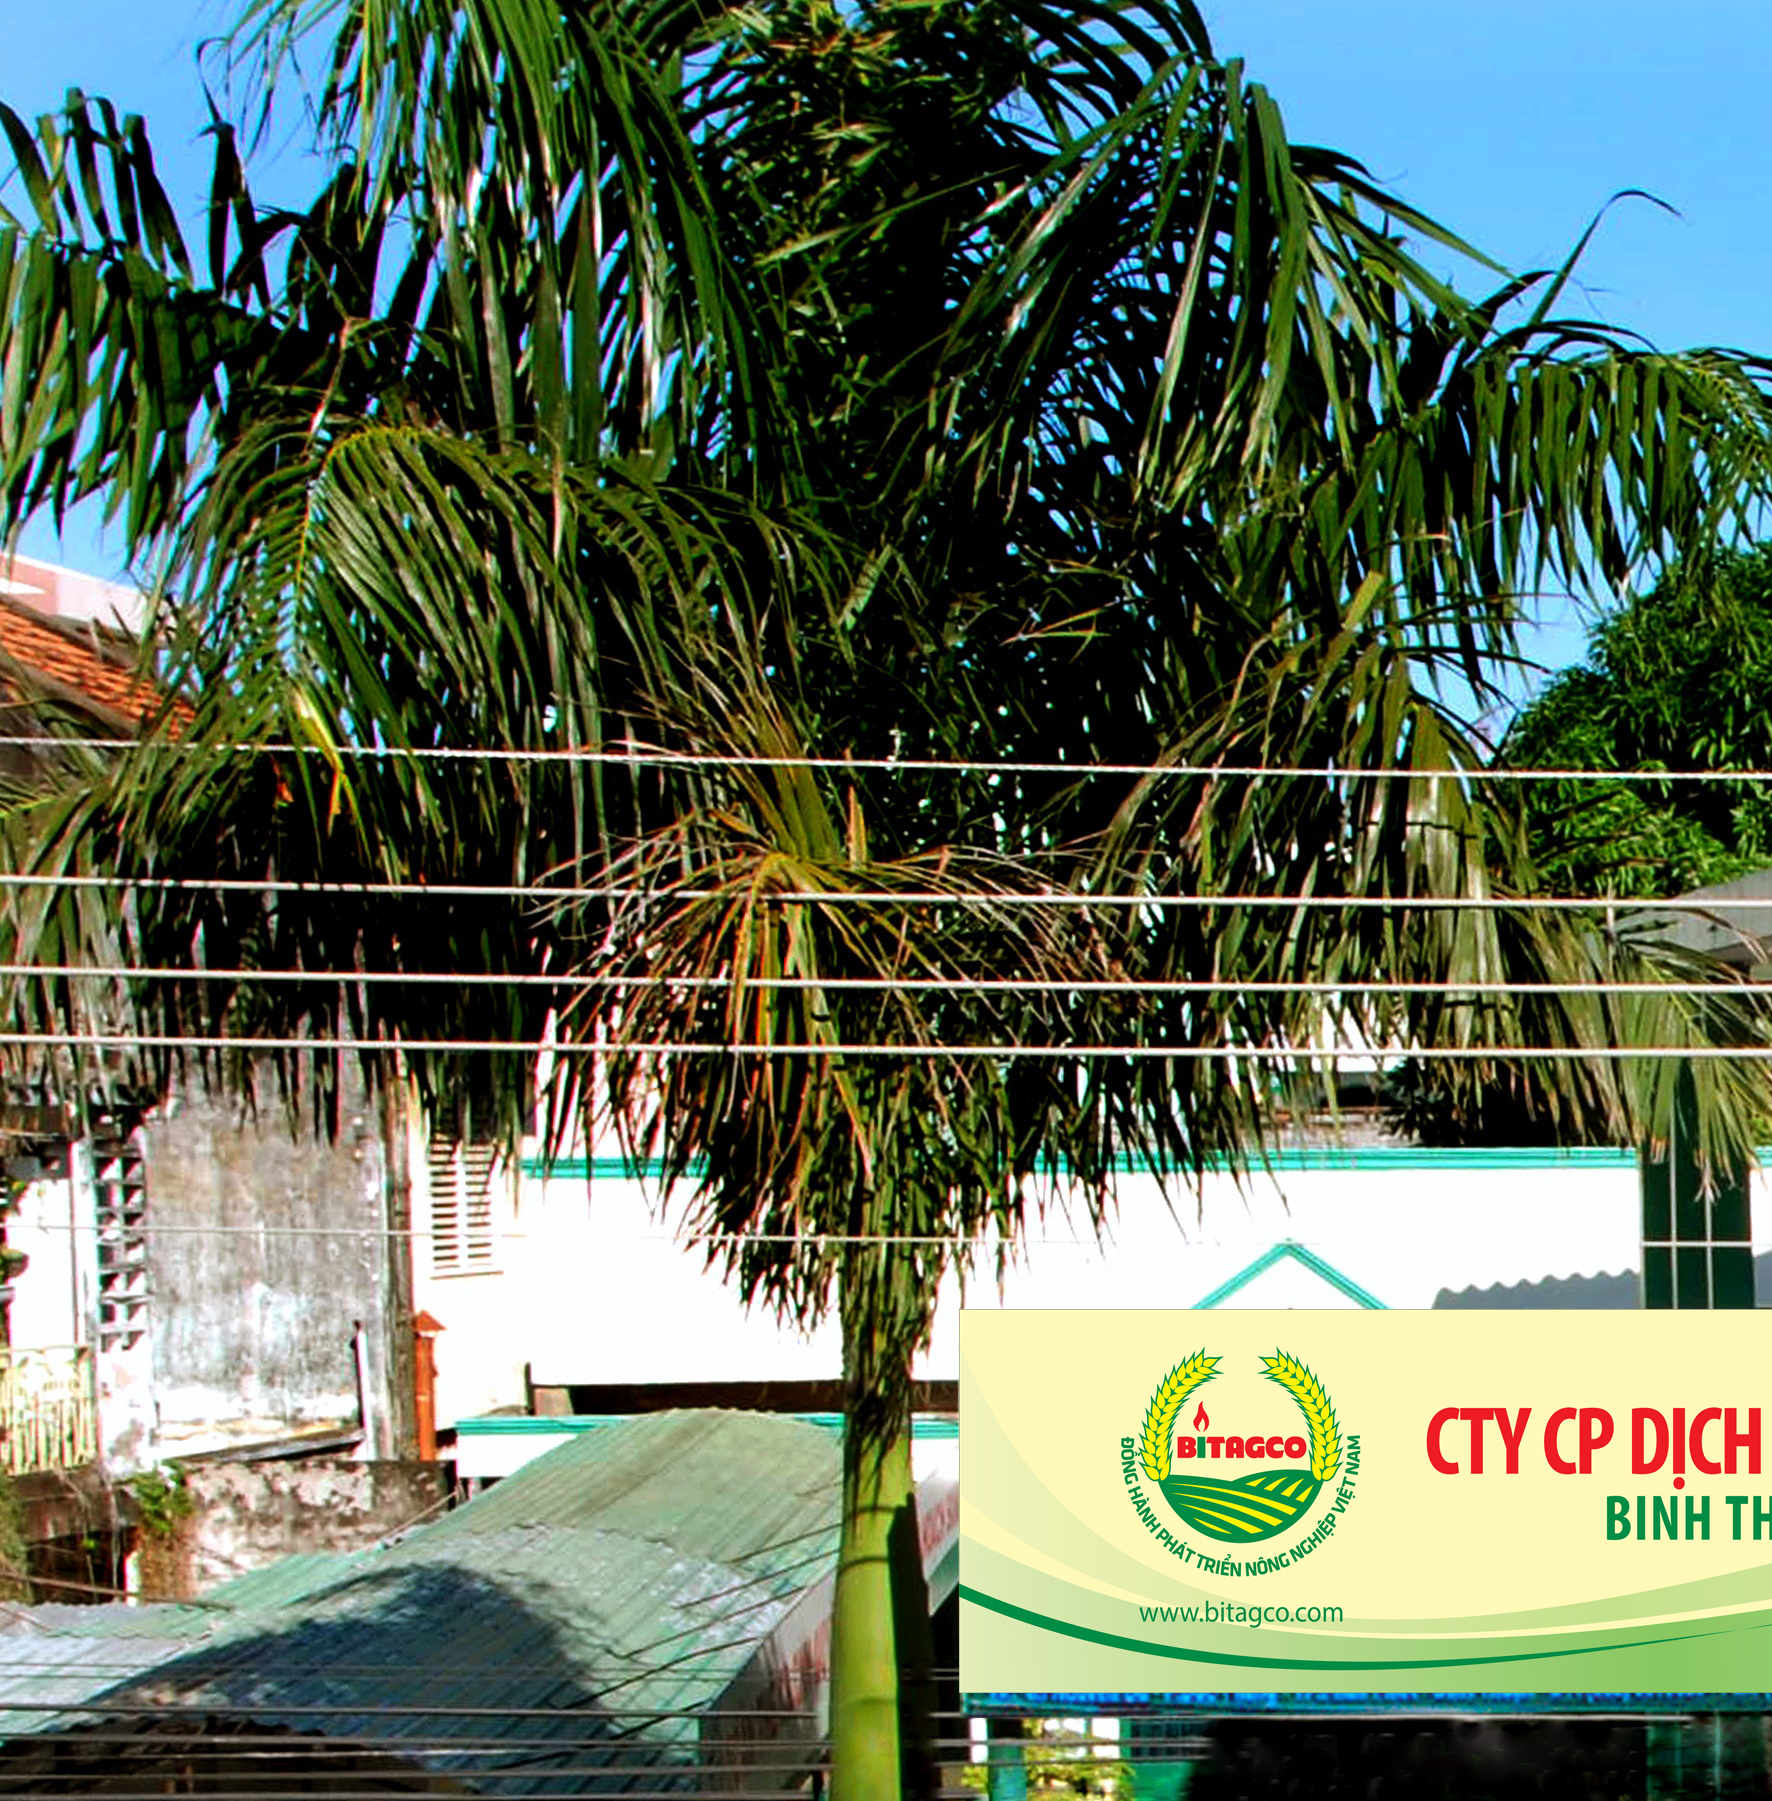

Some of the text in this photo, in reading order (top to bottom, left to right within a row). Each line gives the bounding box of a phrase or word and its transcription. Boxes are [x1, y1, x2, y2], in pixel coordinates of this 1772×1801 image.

[1178, 1437, 1306, 1458] BITAGCO
[1427, 1408, 1532, 1474] CTY
[1544, 1408, 1614, 1474] CP
[1632, 1408, 1761, 1489] DỊCH
[1121, 1435, 1361, 1577] ĐỒNG HÀNH PHÁT TRIỂN NÔNG NGHIỆP VIỆT NAM
[1607, 1496, 1710, 1540] BINH
[1139, 1600, 1343, 1628] www.bitagco.com
